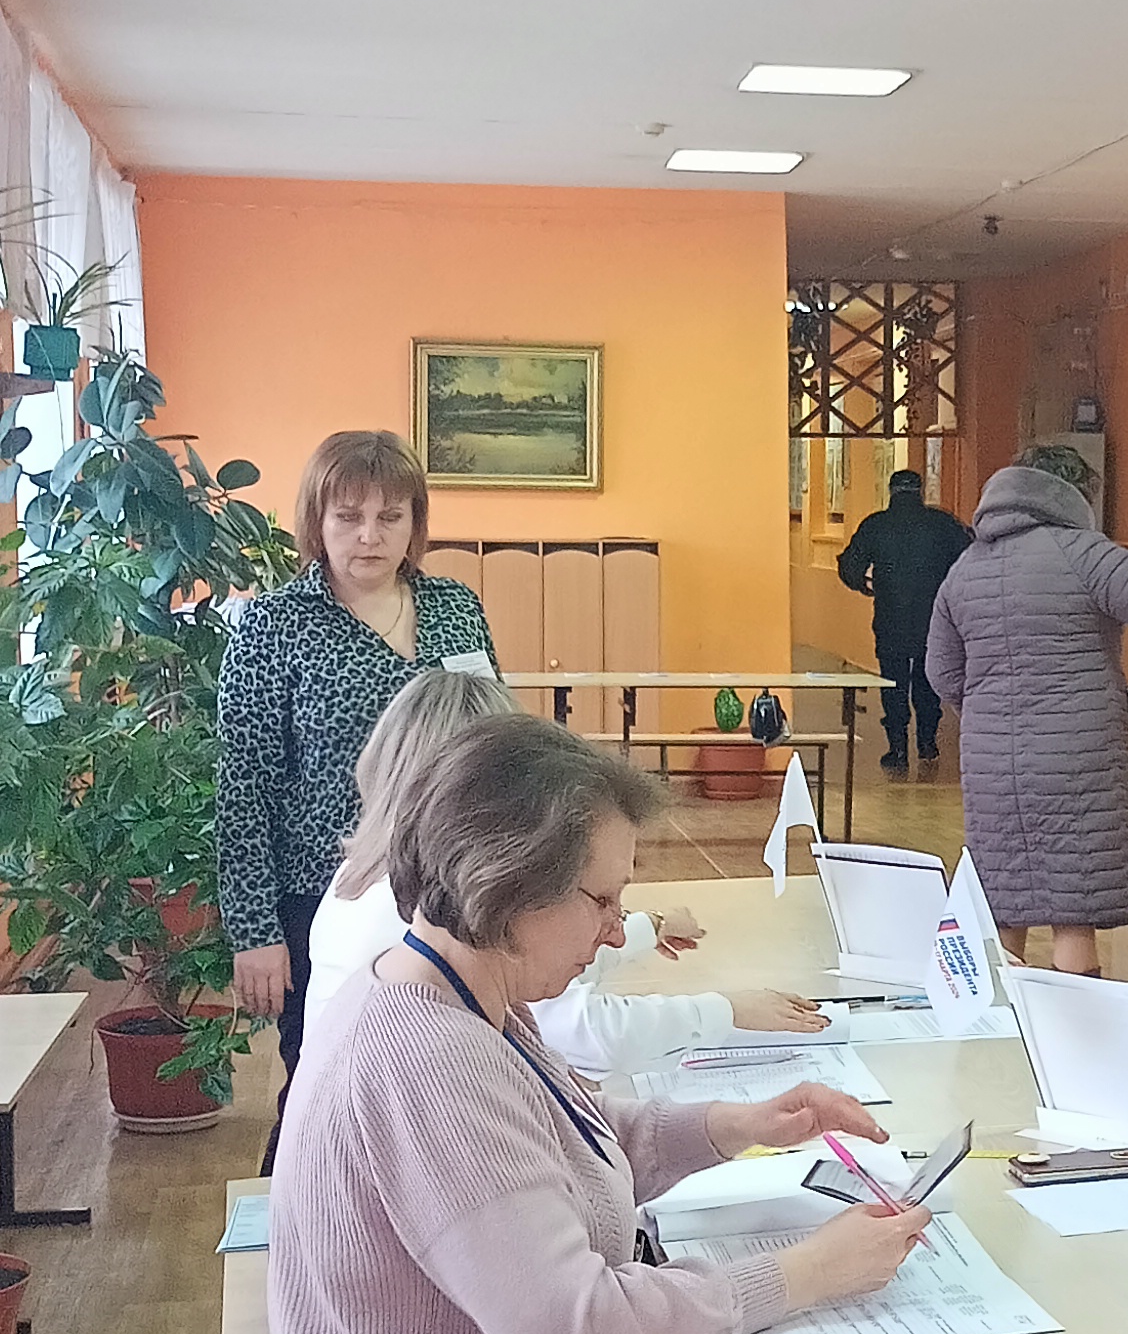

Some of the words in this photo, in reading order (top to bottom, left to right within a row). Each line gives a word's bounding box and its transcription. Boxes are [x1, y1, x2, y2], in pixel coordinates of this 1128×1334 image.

[938, 938, 960, 975] РОССИИ
[938, 958, 952, 982] МАРТА
[947, 936, 978, 995] ПРЕЗИДЕНТА
[956, 935, 979, 976] ВЫБОРЫ
